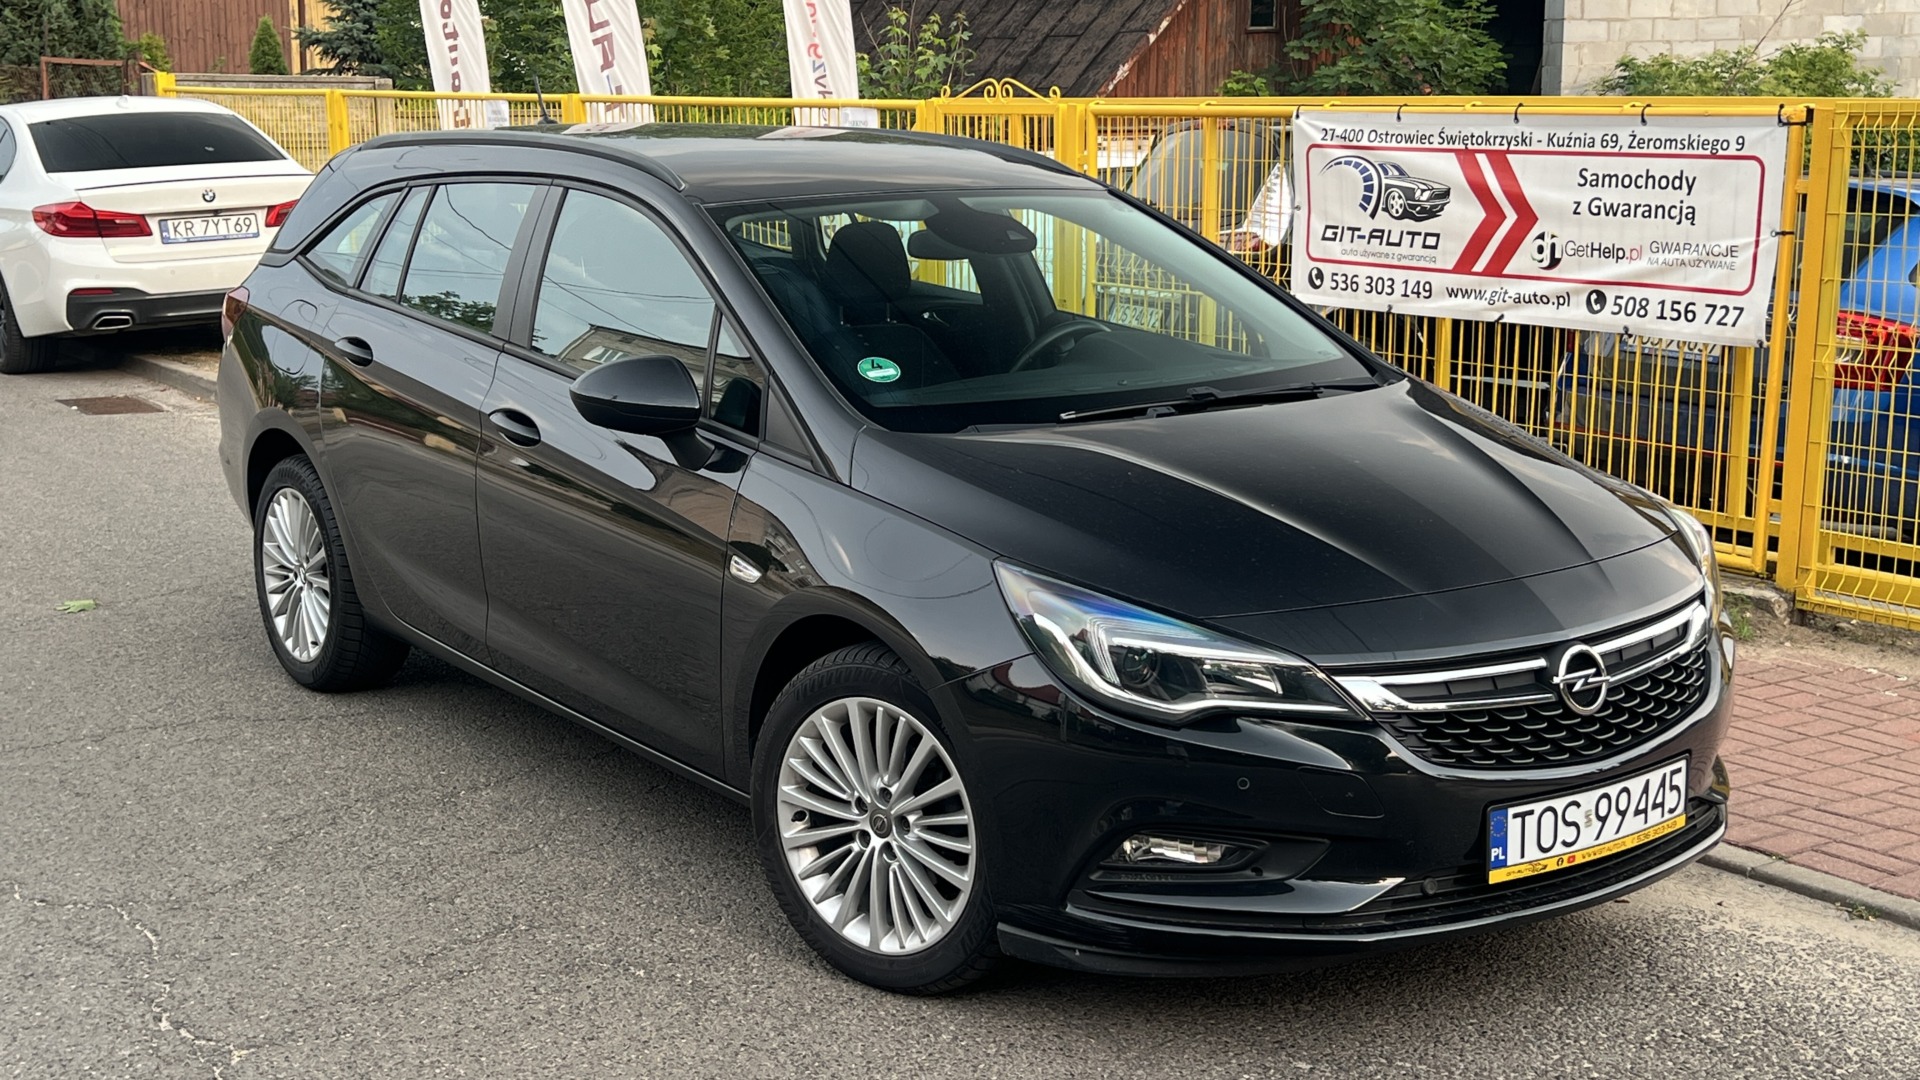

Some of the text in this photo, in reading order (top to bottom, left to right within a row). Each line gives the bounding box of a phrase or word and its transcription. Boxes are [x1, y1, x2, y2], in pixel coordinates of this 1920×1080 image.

[1320, 127, 1364, 143] 27-400
[1367, 128, 1434, 145] Ostrowiec
[1437, 127, 1533, 151] Świętokrzyski
[1547, 131, 1596, 149] Kuźnia
[1600, 133, 1624, 152] 69,
[1628, 130, 1730, 155] Żeromskiego
[1735, 135, 1746, 152] 9
[1577, 167, 1697, 196] Samochody
[1572, 197, 1697, 226] z Gwarancją
[172, 220, 196, 238] KR
[201, 217, 252, 236] 7YT69
[1320, 225, 1441, 250] GIT-AUTO
[1340, 247, 1437, 265] auta używane z gwarancją
[1564, 240, 1643, 264] GetHelp.pl
[1649, 240, 1740, 258] GWARANCJE
[1647, 257, 1660, 266] NA
[1661, 258, 1687, 268] AUTA
[1330, 272, 1433, 300] 536 303 149
[1446, 285, 1571, 311] www.git-auto.pl
[1611, 295, 1745, 328] 508 156 727
[1512, 766, 1683, 859] TOS 99445
[1490, 847, 1506, 862] PL
